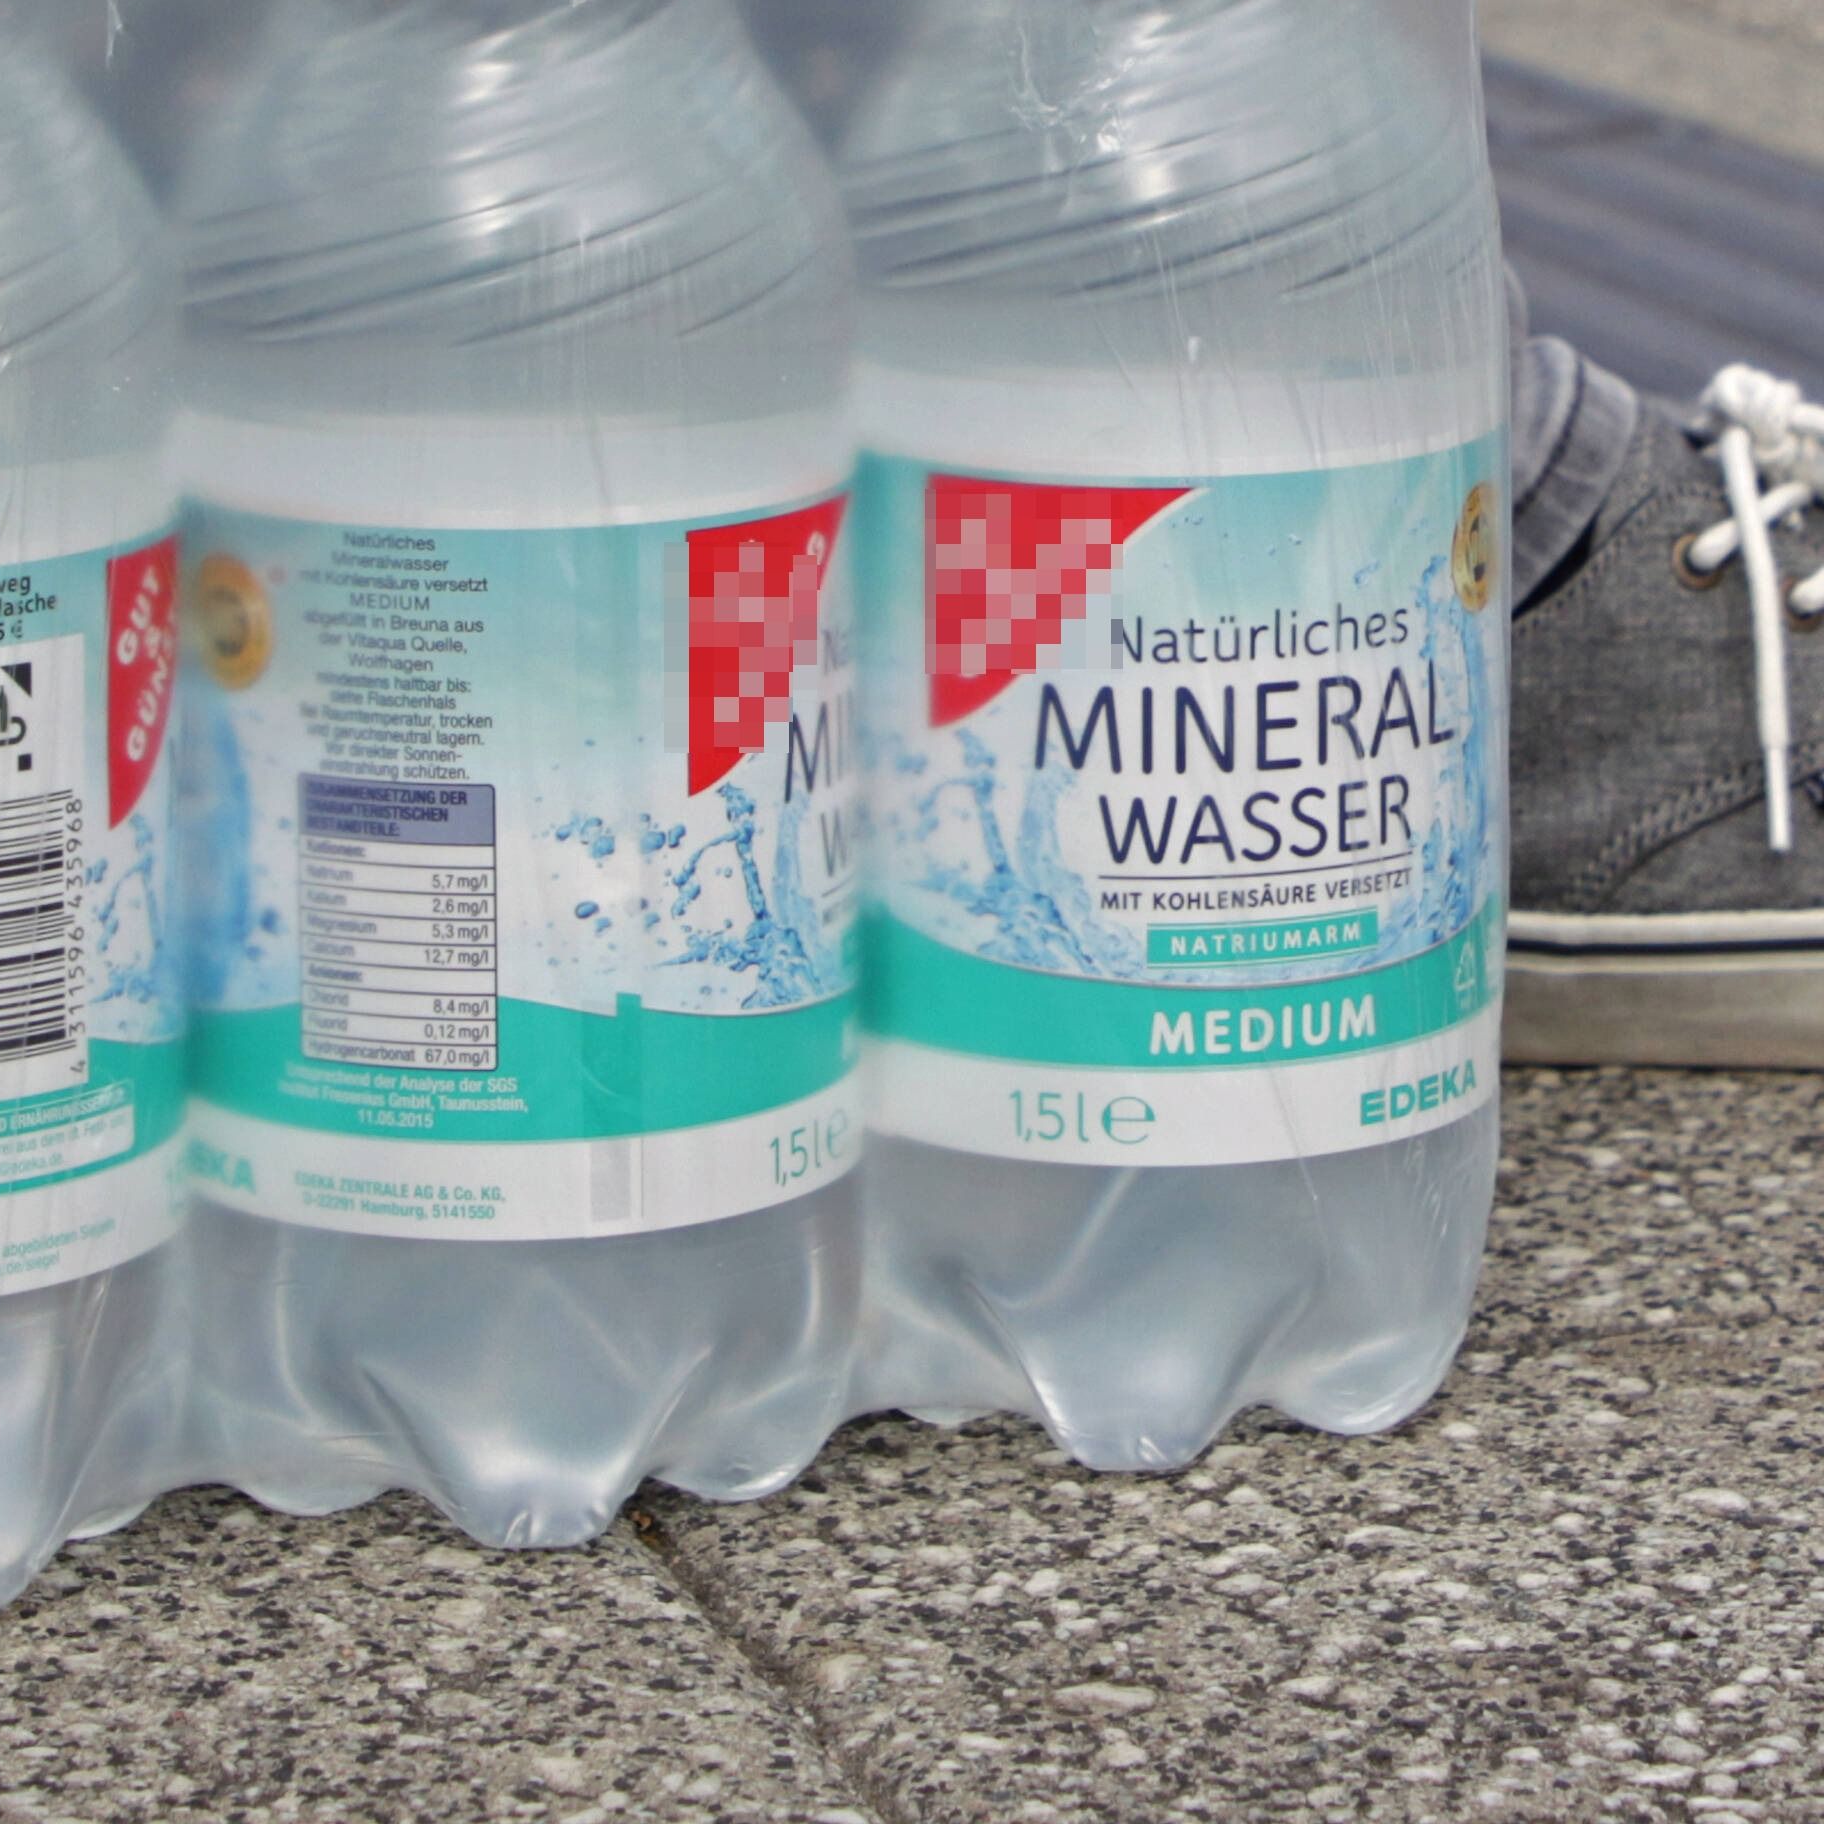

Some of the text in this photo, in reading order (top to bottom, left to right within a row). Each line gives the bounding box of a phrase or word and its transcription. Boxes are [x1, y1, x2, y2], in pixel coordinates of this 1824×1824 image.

[342, 532, 437, 552] Natürliches
[330, 550, 450, 572] Mineralwasser
[423, 577, 489, 593] versetzt
[349, 591, 431, 611] MEDIUM
[390, 614, 450, 632] Breuna
[453, 619, 485, 633] aus
[1114, 603, 1409, 665] Natürliches
[410, 636, 468, 655] Quelle,
[445, 678, 473, 693] bis:
[367, 691, 457, 711] Flaschenhals
[439, 713, 494, 729] trocken
[1033, 659, 1456, 776] MINERAL
[436, 730, 486, 749] lagern.
[403, 746, 464, 763] Sonnen-
[402, 762, 471, 781] schützen.
[439, 789, 468, 806] DER
[1098, 774, 1412, 865] WASSER
[431, 874, 455, 891] 5,7
[457, 874, 489, 892] mg/l
[1100, 867, 1412, 912] MIT KOHLENSÄURE VERSETZT
[431, 898, 455, 915] 2,6
[457, 898, 489, 917] mg/l
[431, 924, 455, 941] 5,3
[457, 924, 489, 942] mg/l
[1169, 922, 1362, 957] NATRIUMARM
[423, 948, 455, 965] 12,7
[457, 948, 489, 967] mg/l
[432, 998, 456, 1015] 8,4
[457, 998, 490, 1017] mg/l
[423, 1023, 456, 1041] 0,12
[457, 1023, 490, 1043] mg/l
[1149, 993, 1376, 1056] MEDIUM
[424, 1049, 457, 1066] 67,0
[457, 1049, 490, 1067] mg/l
[399, 1075, 456, 1094] Analyse
[458, 1077, 485, 1093] der
[486, 1077, 518, 1093] SGS
[1359, 1059, 1478, 1128] EDEKA
[387, 1092, 436, 1112] GmbH,
[437, 1095, 529, 1113] Taunusstein,
[338, 1176, 410, 1199] ZENTRALE
[413, 1184, 434, 1201] AG
[437, 1185, 450, 1201] &
[453, 1186, 477, 1202] Co.
[480, 1187, 507, 1204] KG,
[360, 1199, 429, 1222] Hamburg,
[432, 1204, 496, 1220] 5141550
